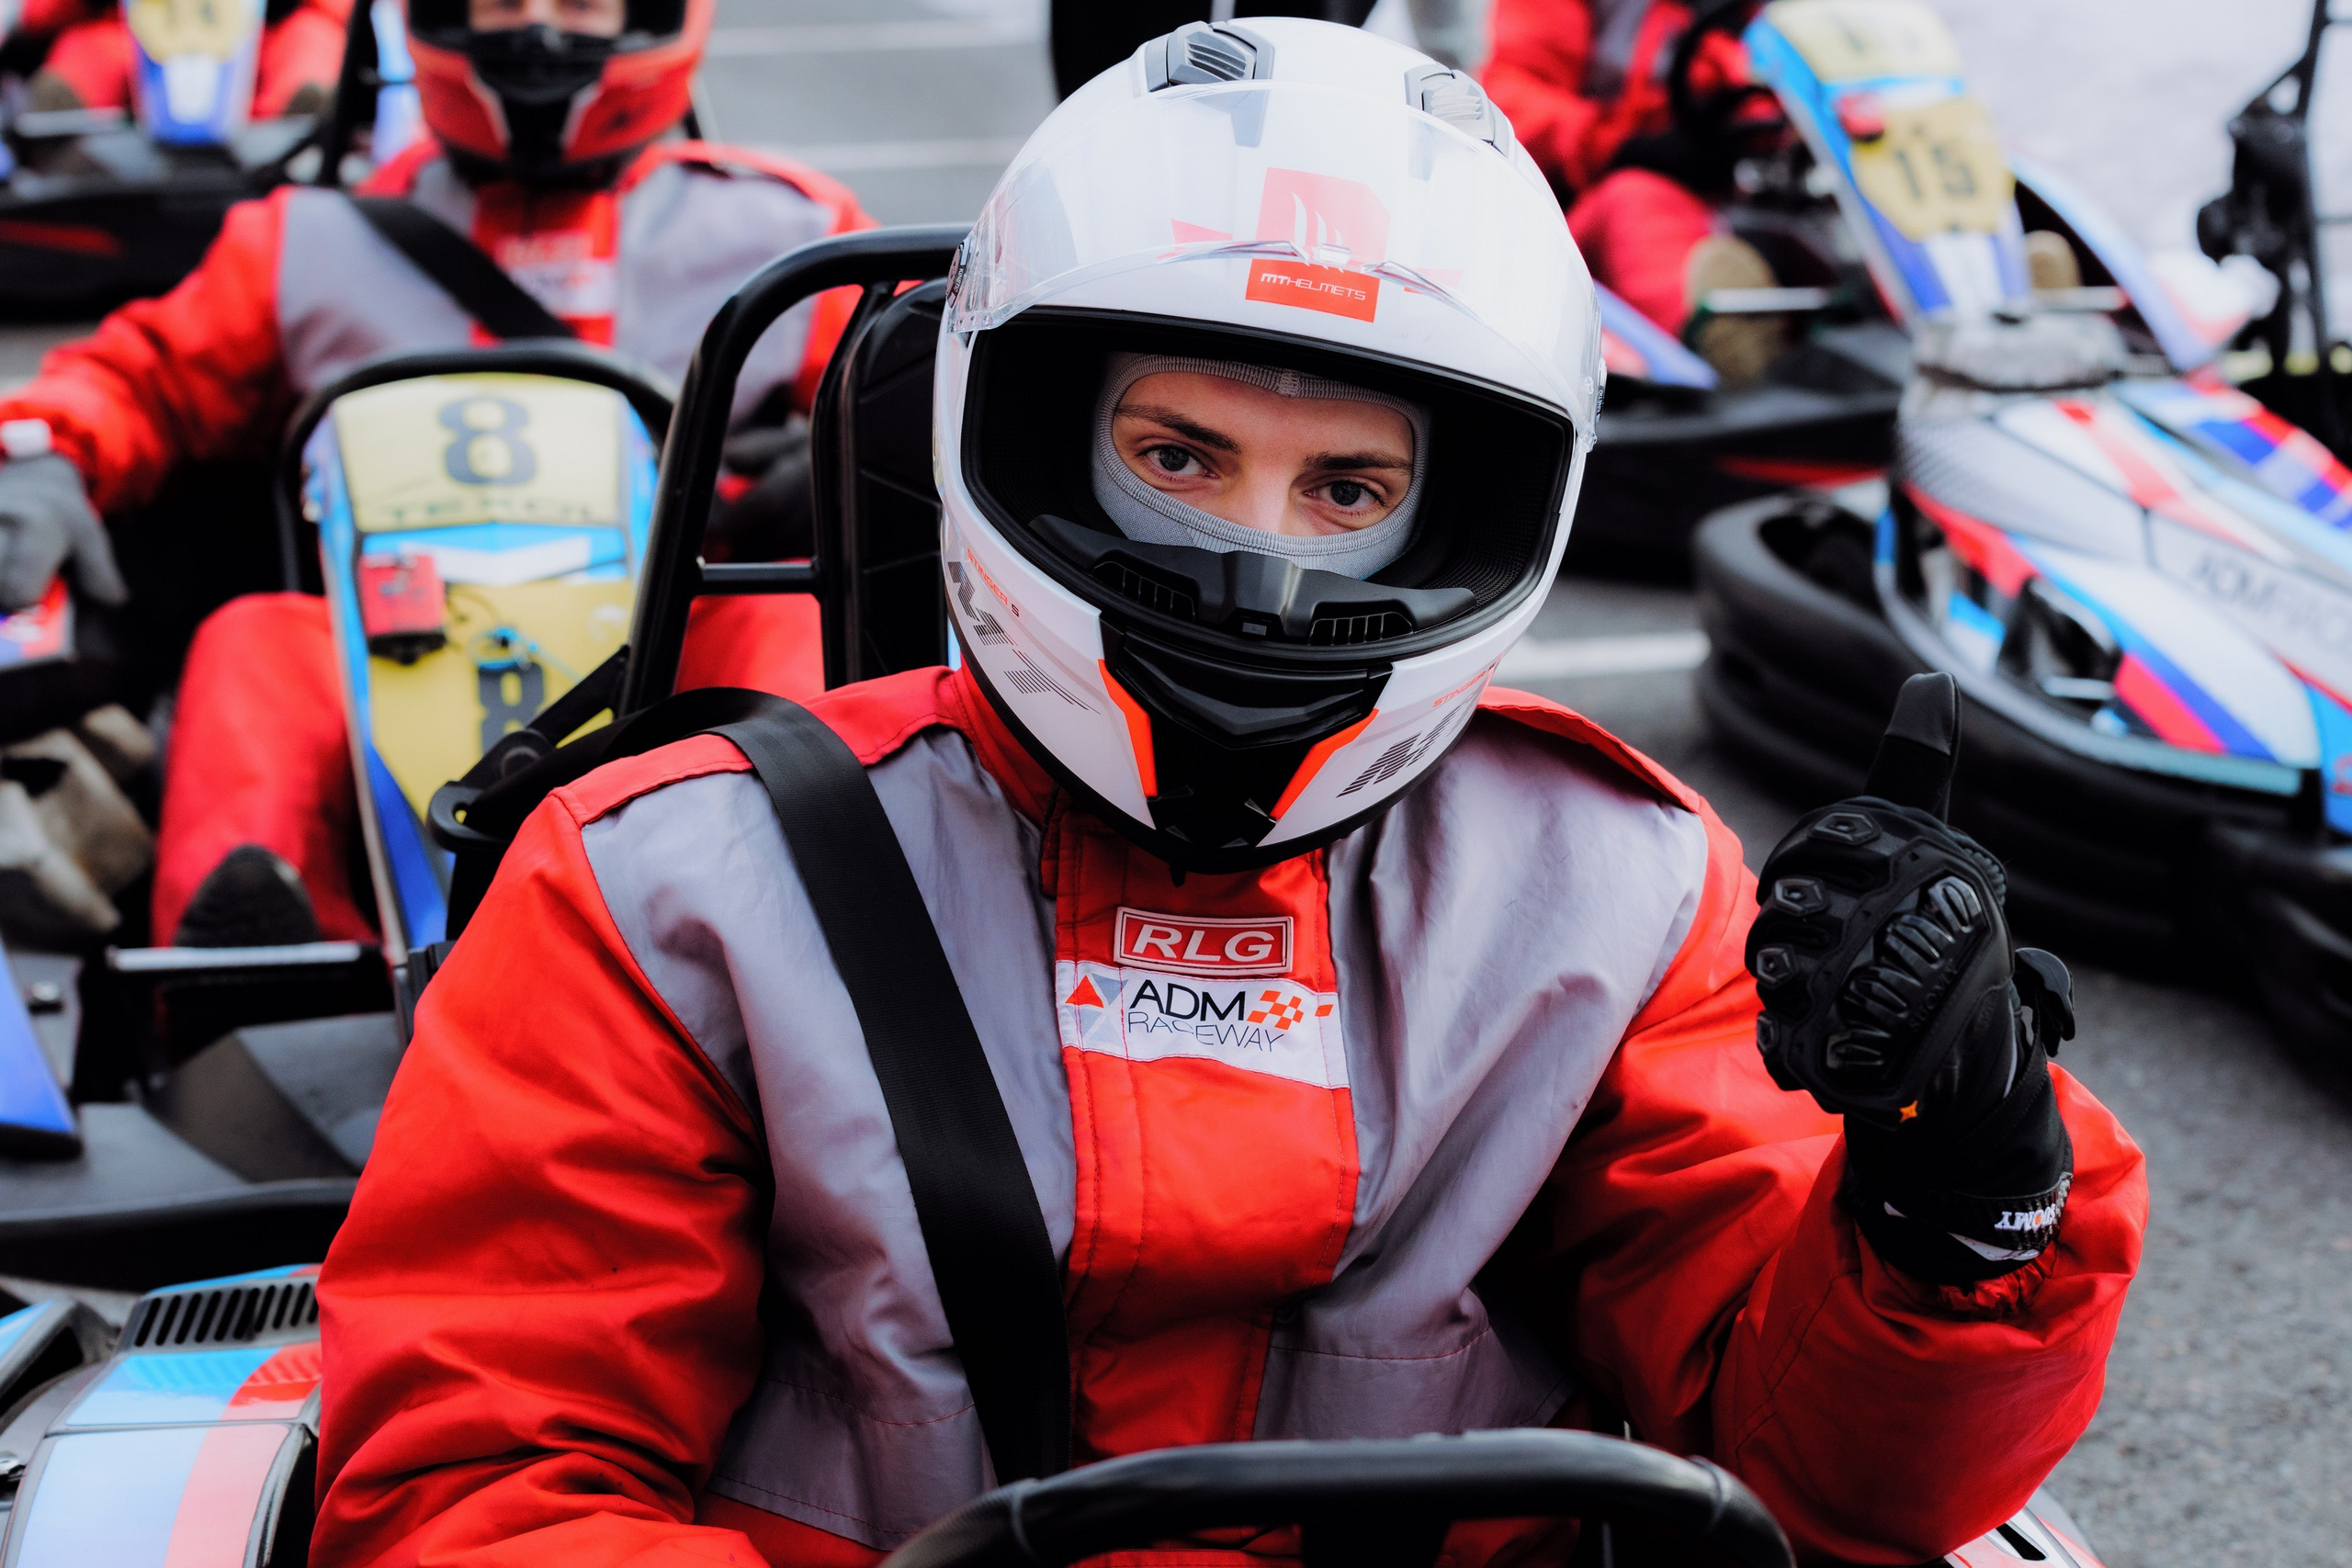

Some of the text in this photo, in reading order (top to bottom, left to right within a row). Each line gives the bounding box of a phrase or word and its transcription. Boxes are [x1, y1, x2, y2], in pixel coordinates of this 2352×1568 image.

[954, 267, 965, 293] KINETIC
[439, 397, 537, 487] 8
[967, 548, 1020, 617] STINGER S
[1132, 923, 1275, 963] RLG
[1129, 979, 1246, 1022] ADM
[1128, 1011, 1284, 1053] RACEWAY
